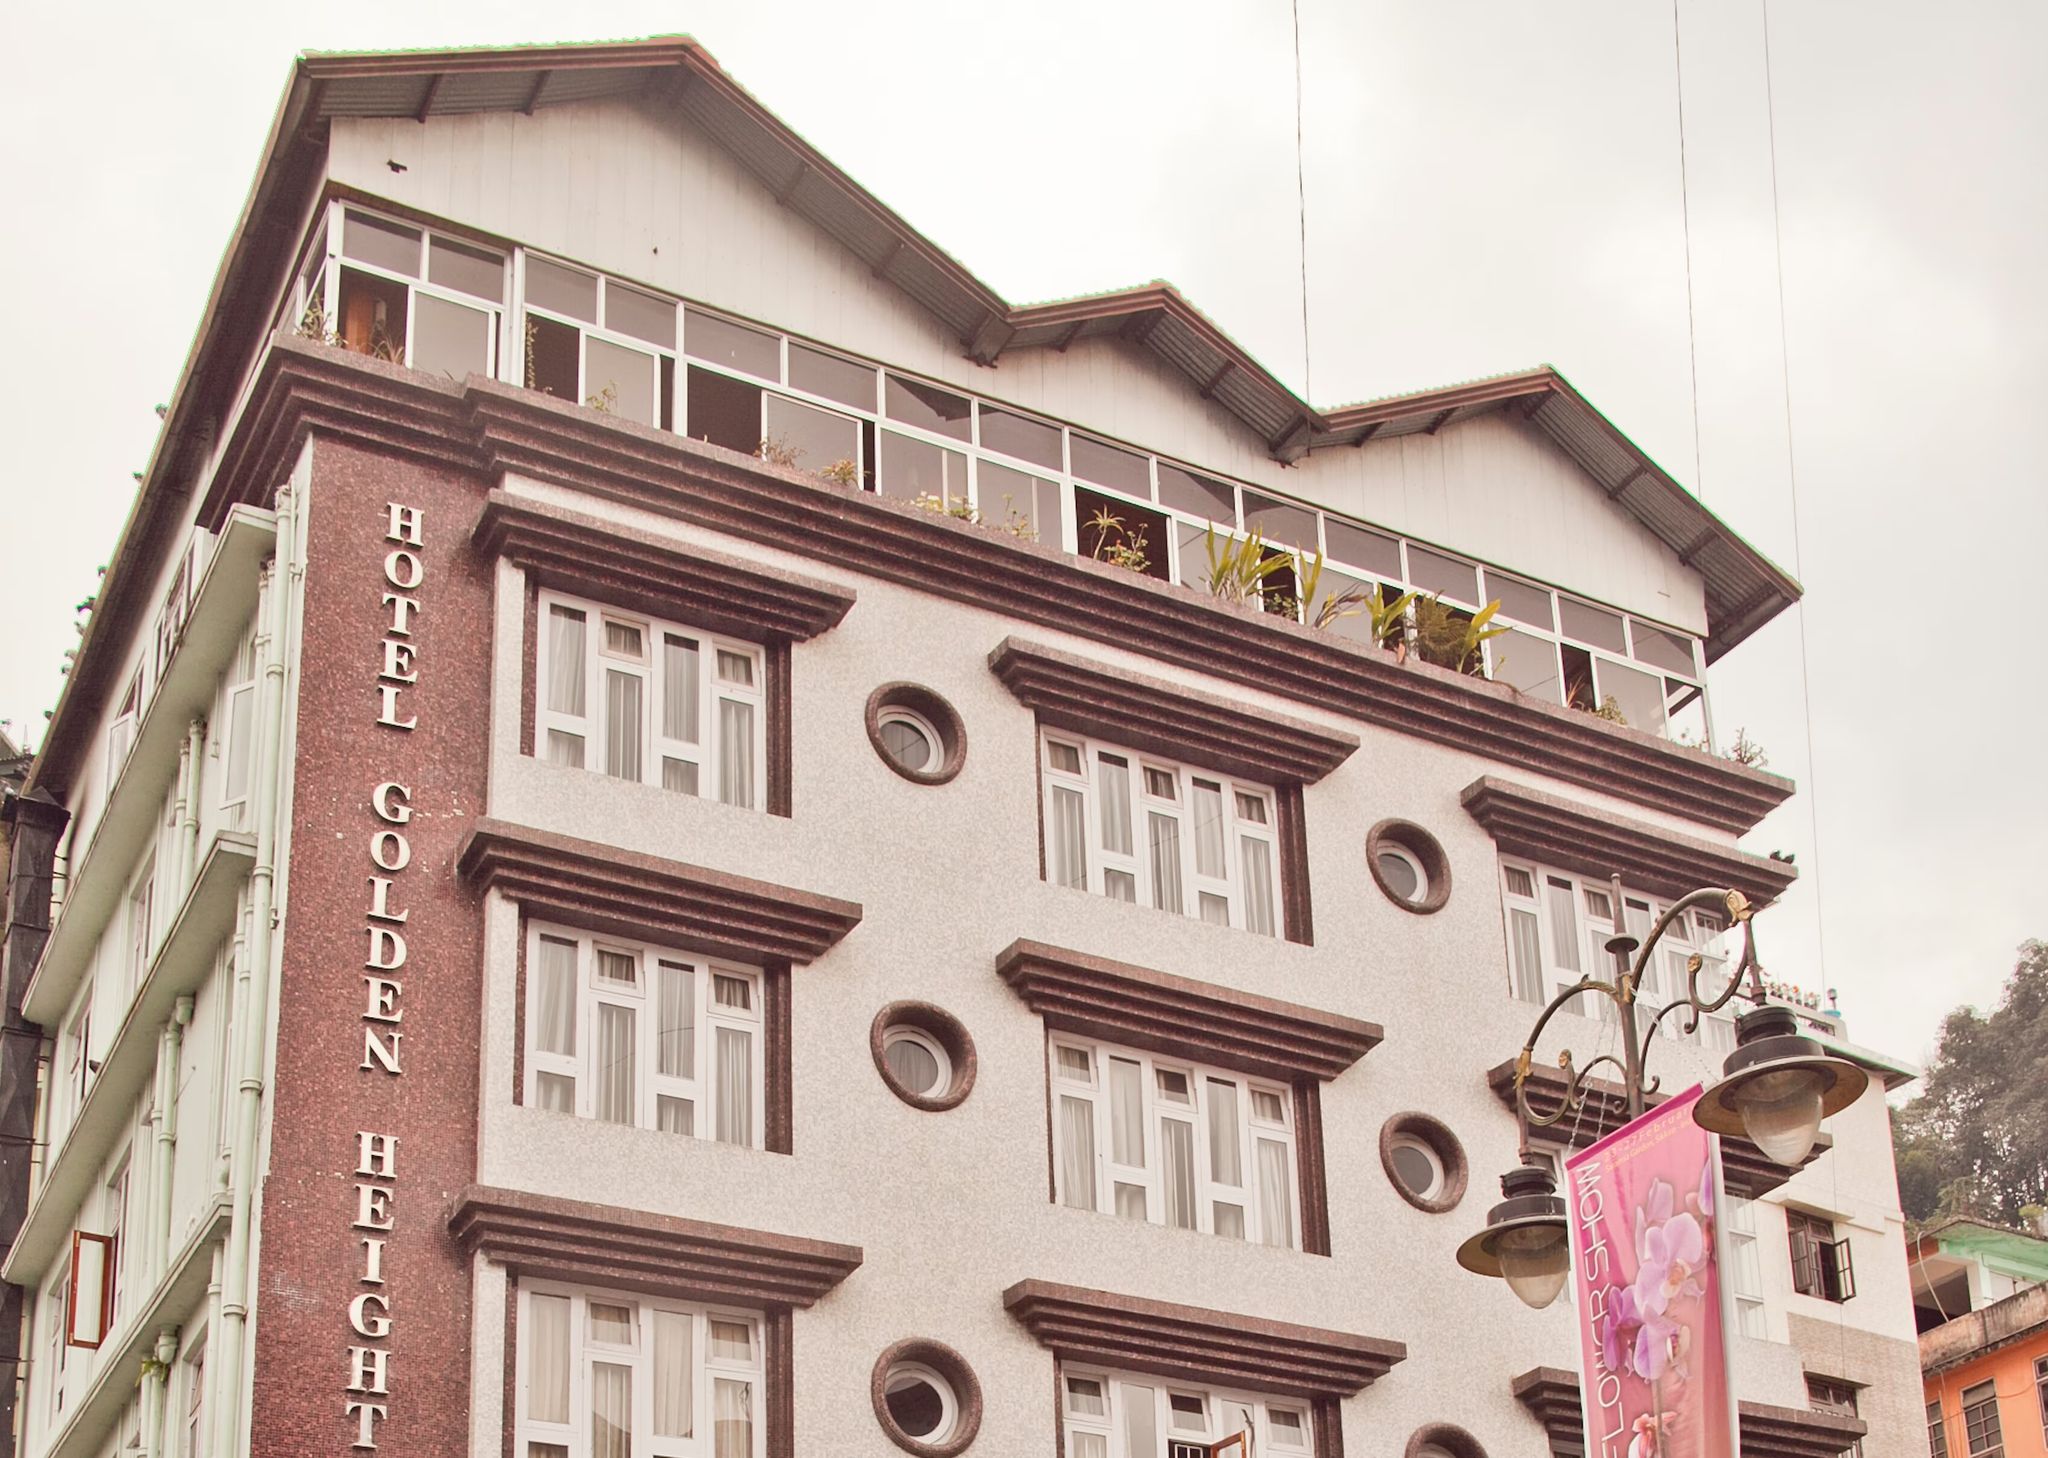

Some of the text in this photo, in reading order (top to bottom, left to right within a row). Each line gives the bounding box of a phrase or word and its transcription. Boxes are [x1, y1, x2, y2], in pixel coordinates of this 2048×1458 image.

[345, 501, 425, 1449] HOTEL GOLDEN HEIGHT
[1576, 1161, 1610, 1282] SHOW
